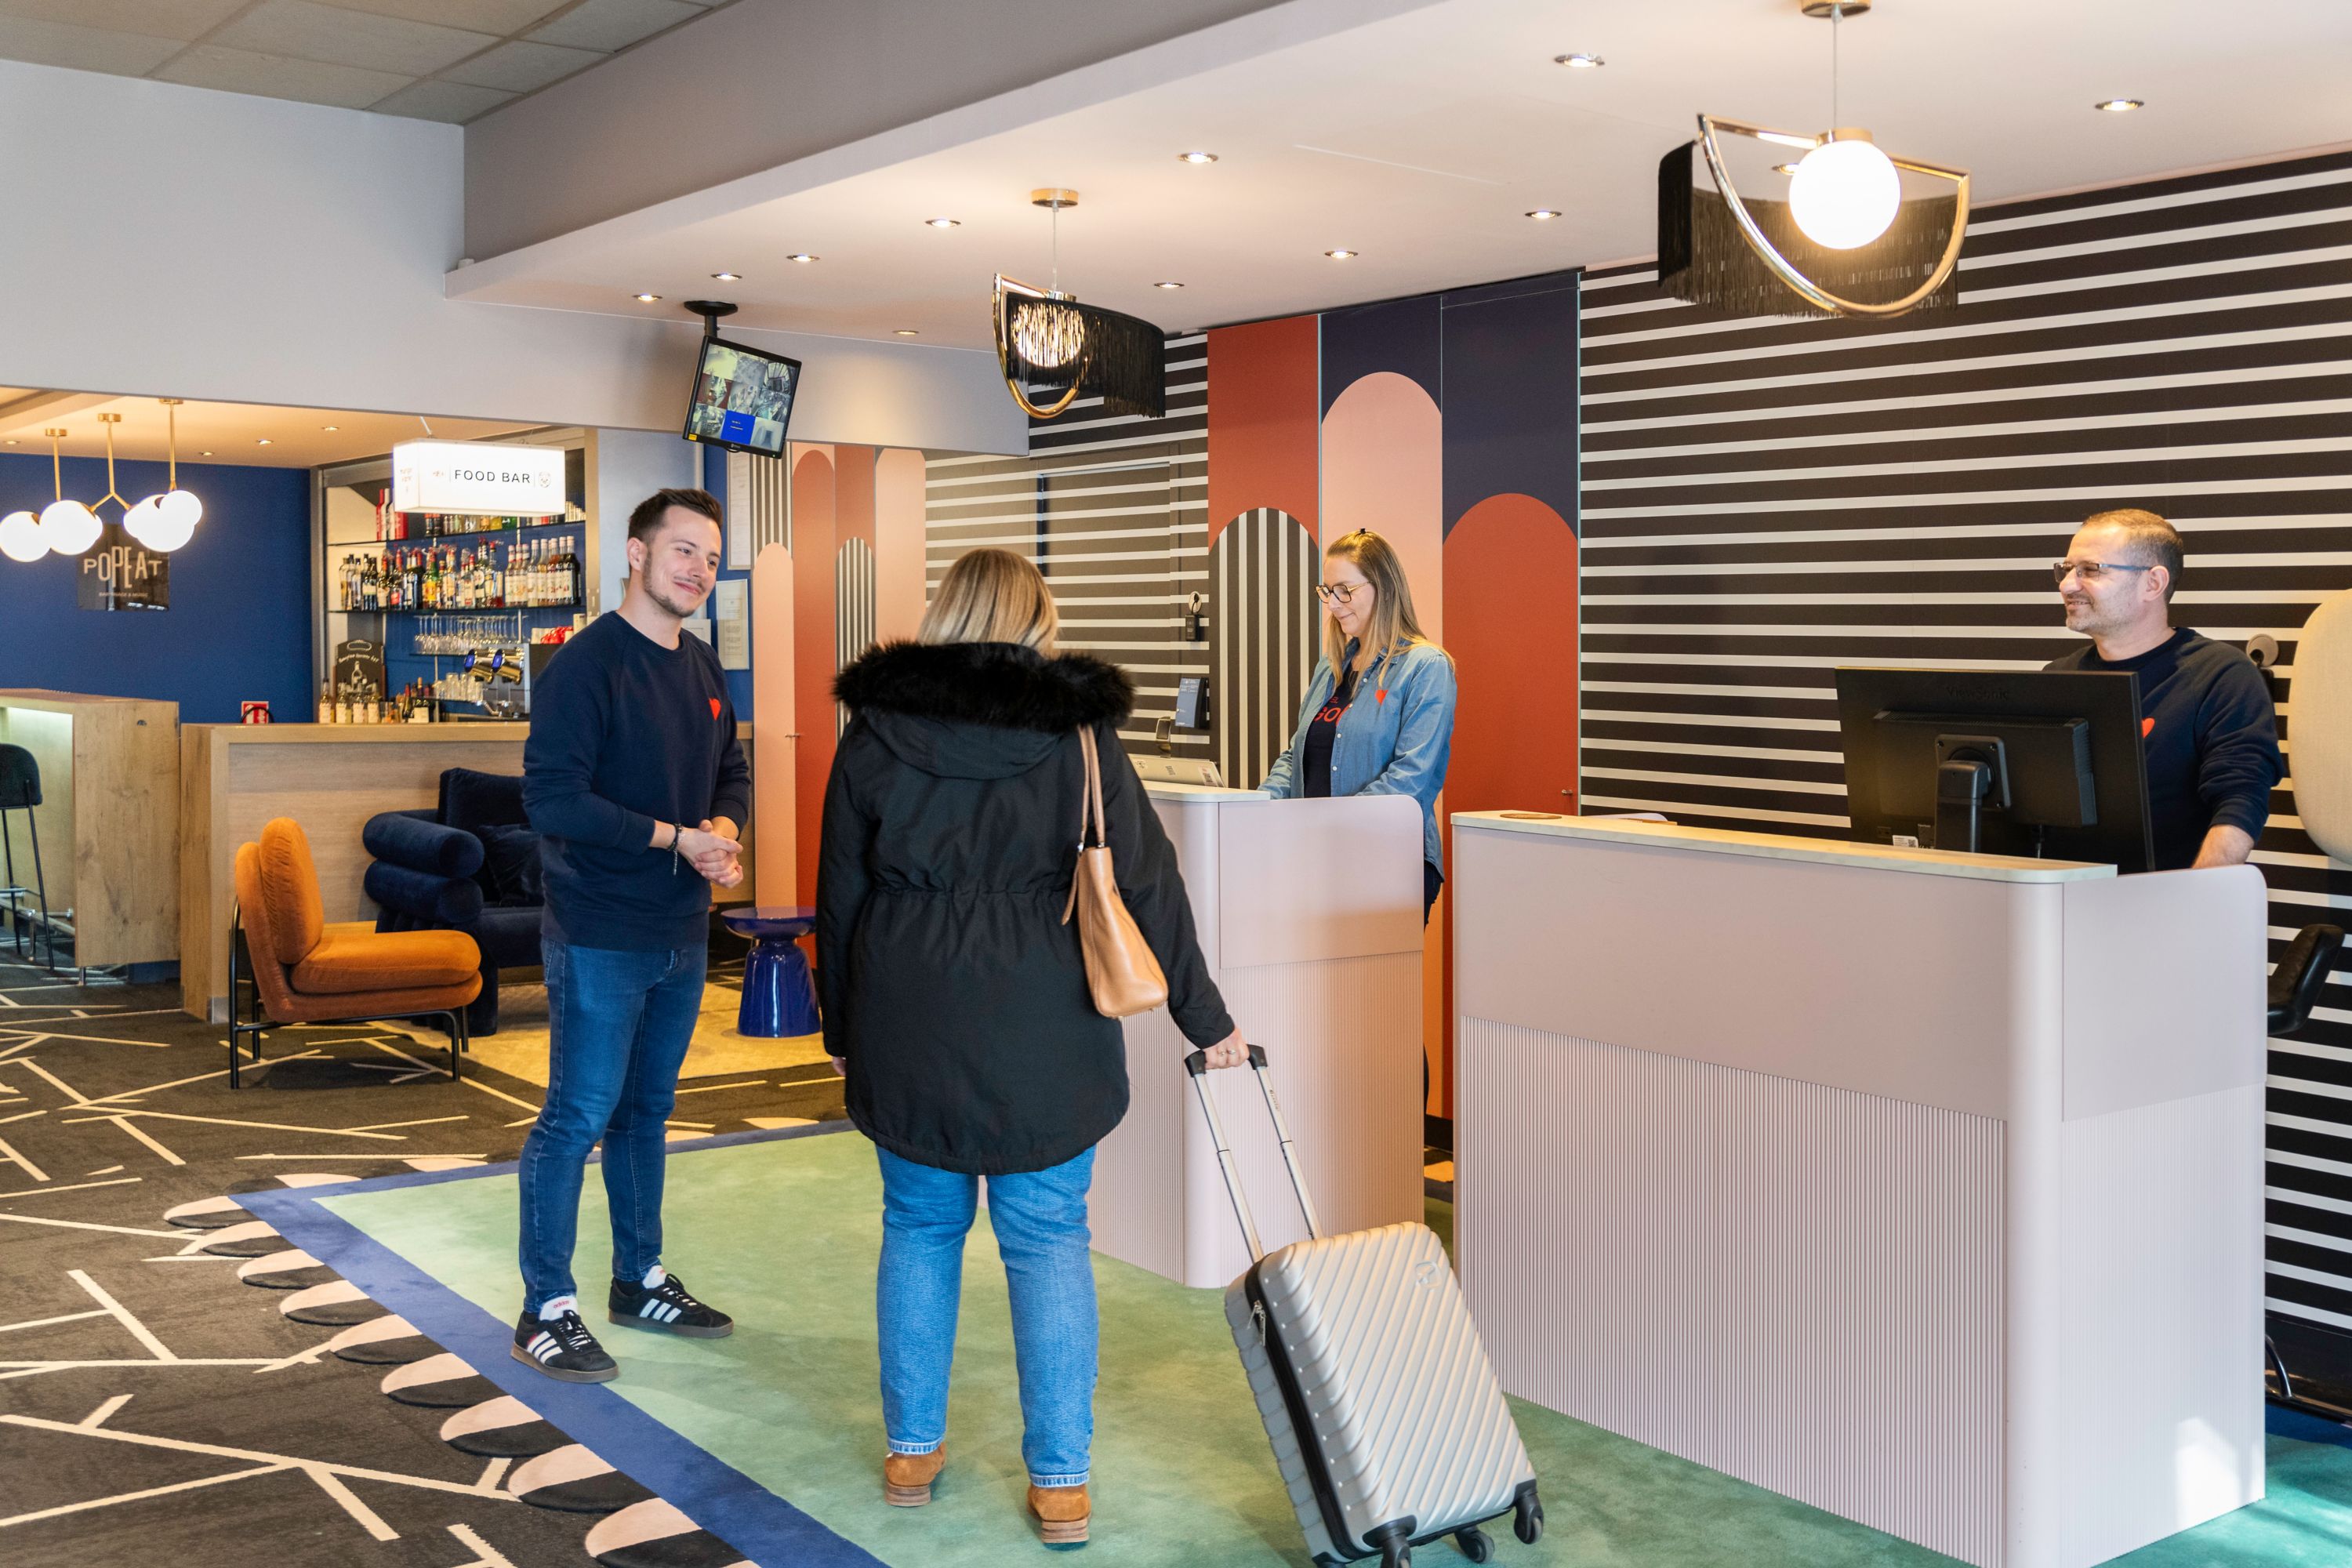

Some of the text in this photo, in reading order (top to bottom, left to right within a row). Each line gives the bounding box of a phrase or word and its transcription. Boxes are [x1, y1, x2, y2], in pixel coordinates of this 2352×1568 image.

[455, 470, 495, 481] FOOD
[502, 472, 530, 484] BAR
[83, 546, 162, 588] POPEAT
